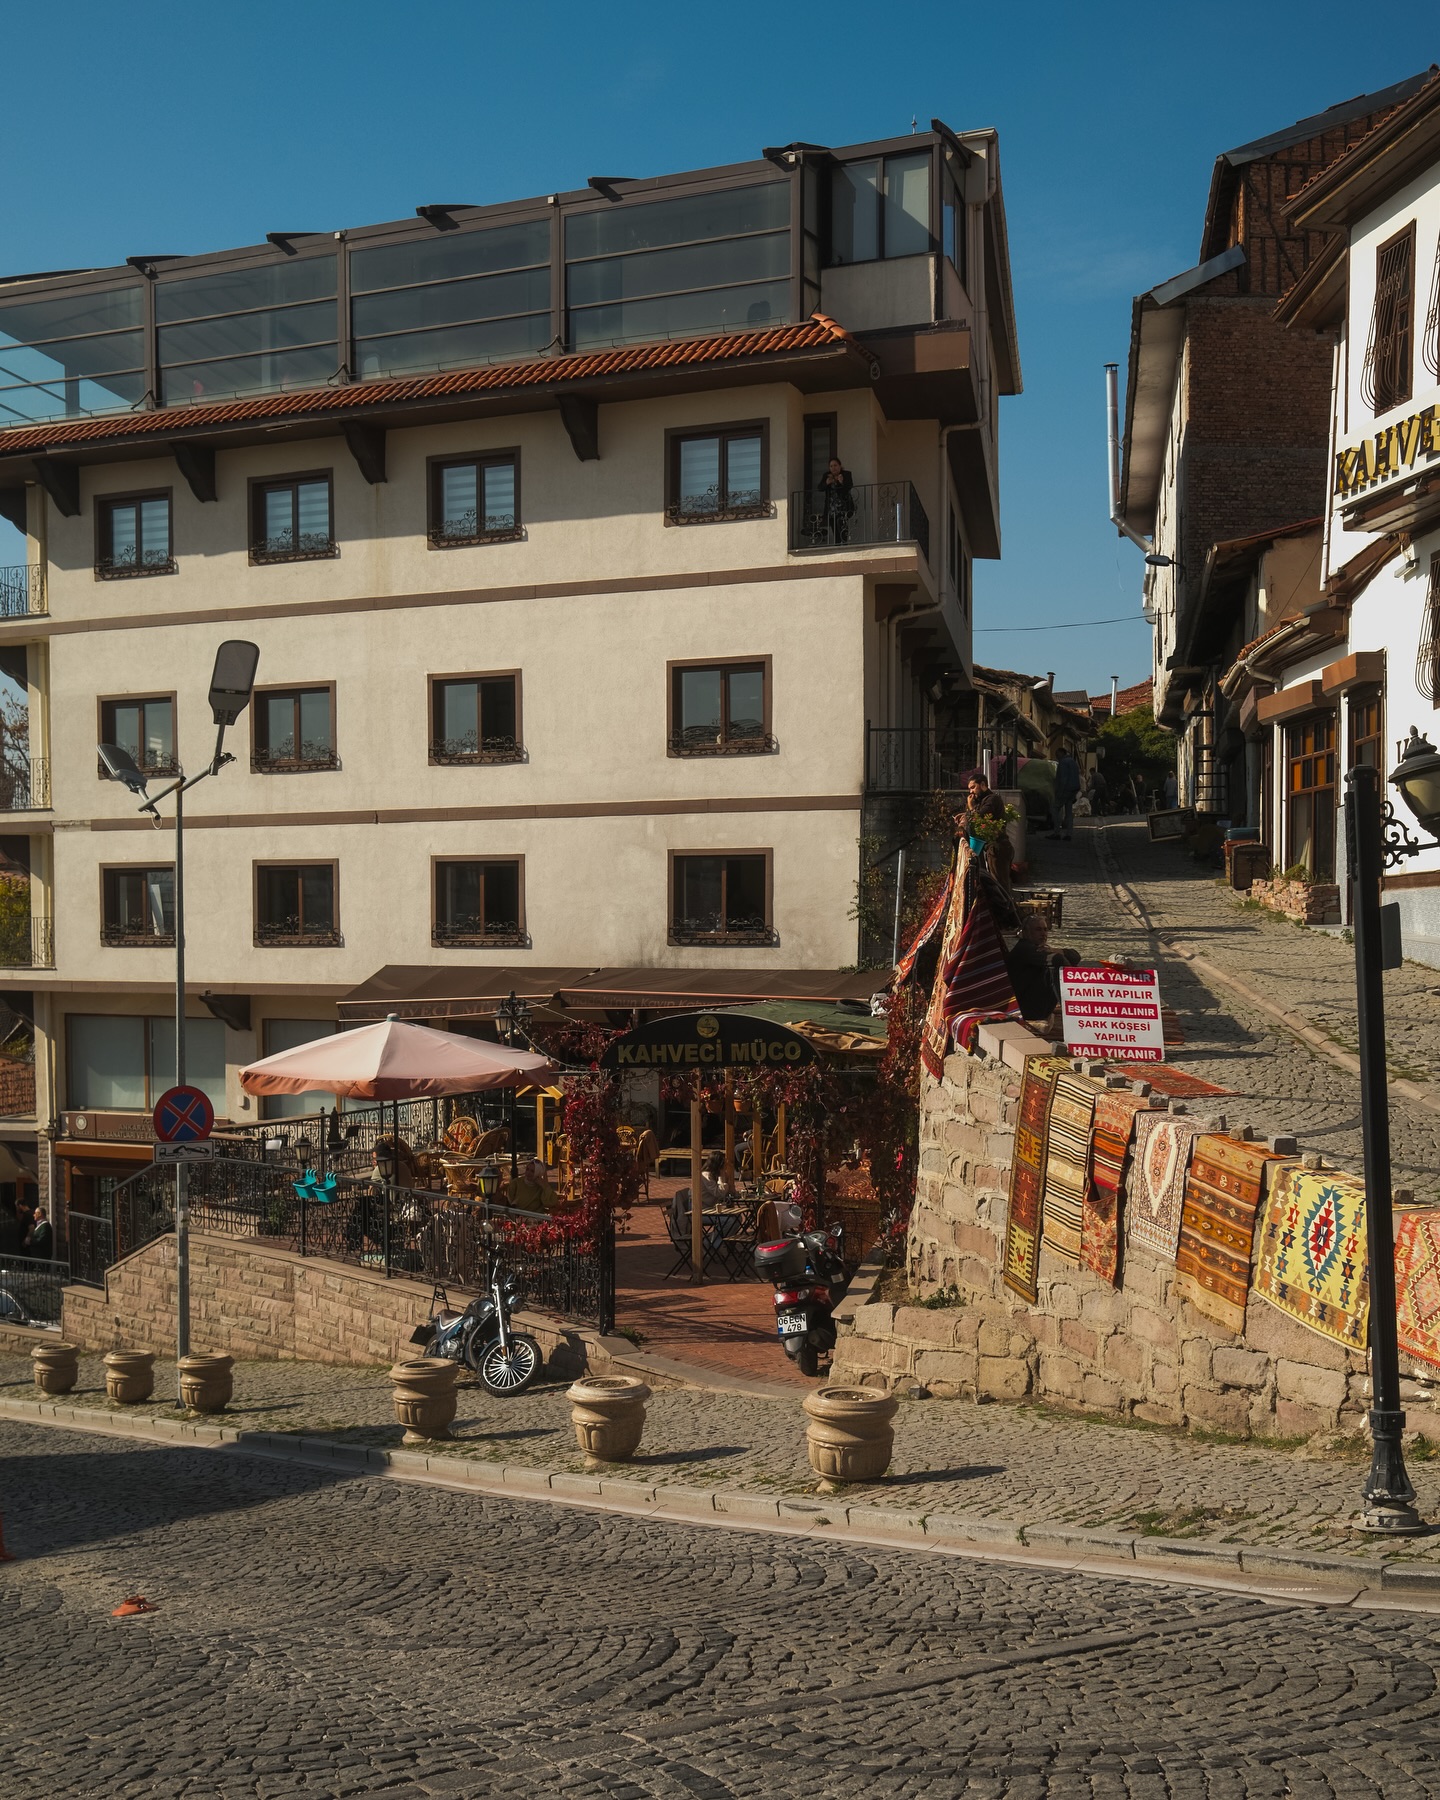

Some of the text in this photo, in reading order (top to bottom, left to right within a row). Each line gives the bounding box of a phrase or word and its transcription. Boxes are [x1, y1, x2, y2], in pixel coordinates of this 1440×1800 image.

[1066, 971, 1151, 982] SAÇAK YAPILIR
[1067, 987, 1153, 999] TAMİR YAPILIR
[1067, 1004, 1155, 1017] ESKİ HALI ALINIR
[1078, 1020, 1151, 1032] ŞARK KÖŞESİ
[1094, 1032, 1137, 1043] YAPILIR
[617, 1039, 801, 1064] KAHVECİ MÜCO
[1073, 1046, 1157, 1060] HALI YIKANIR
[119, 1124, 146, 1132] ANKARA
[778, 1317, 788, 1326] 06
[787, 1323, 802, 1332] 478
